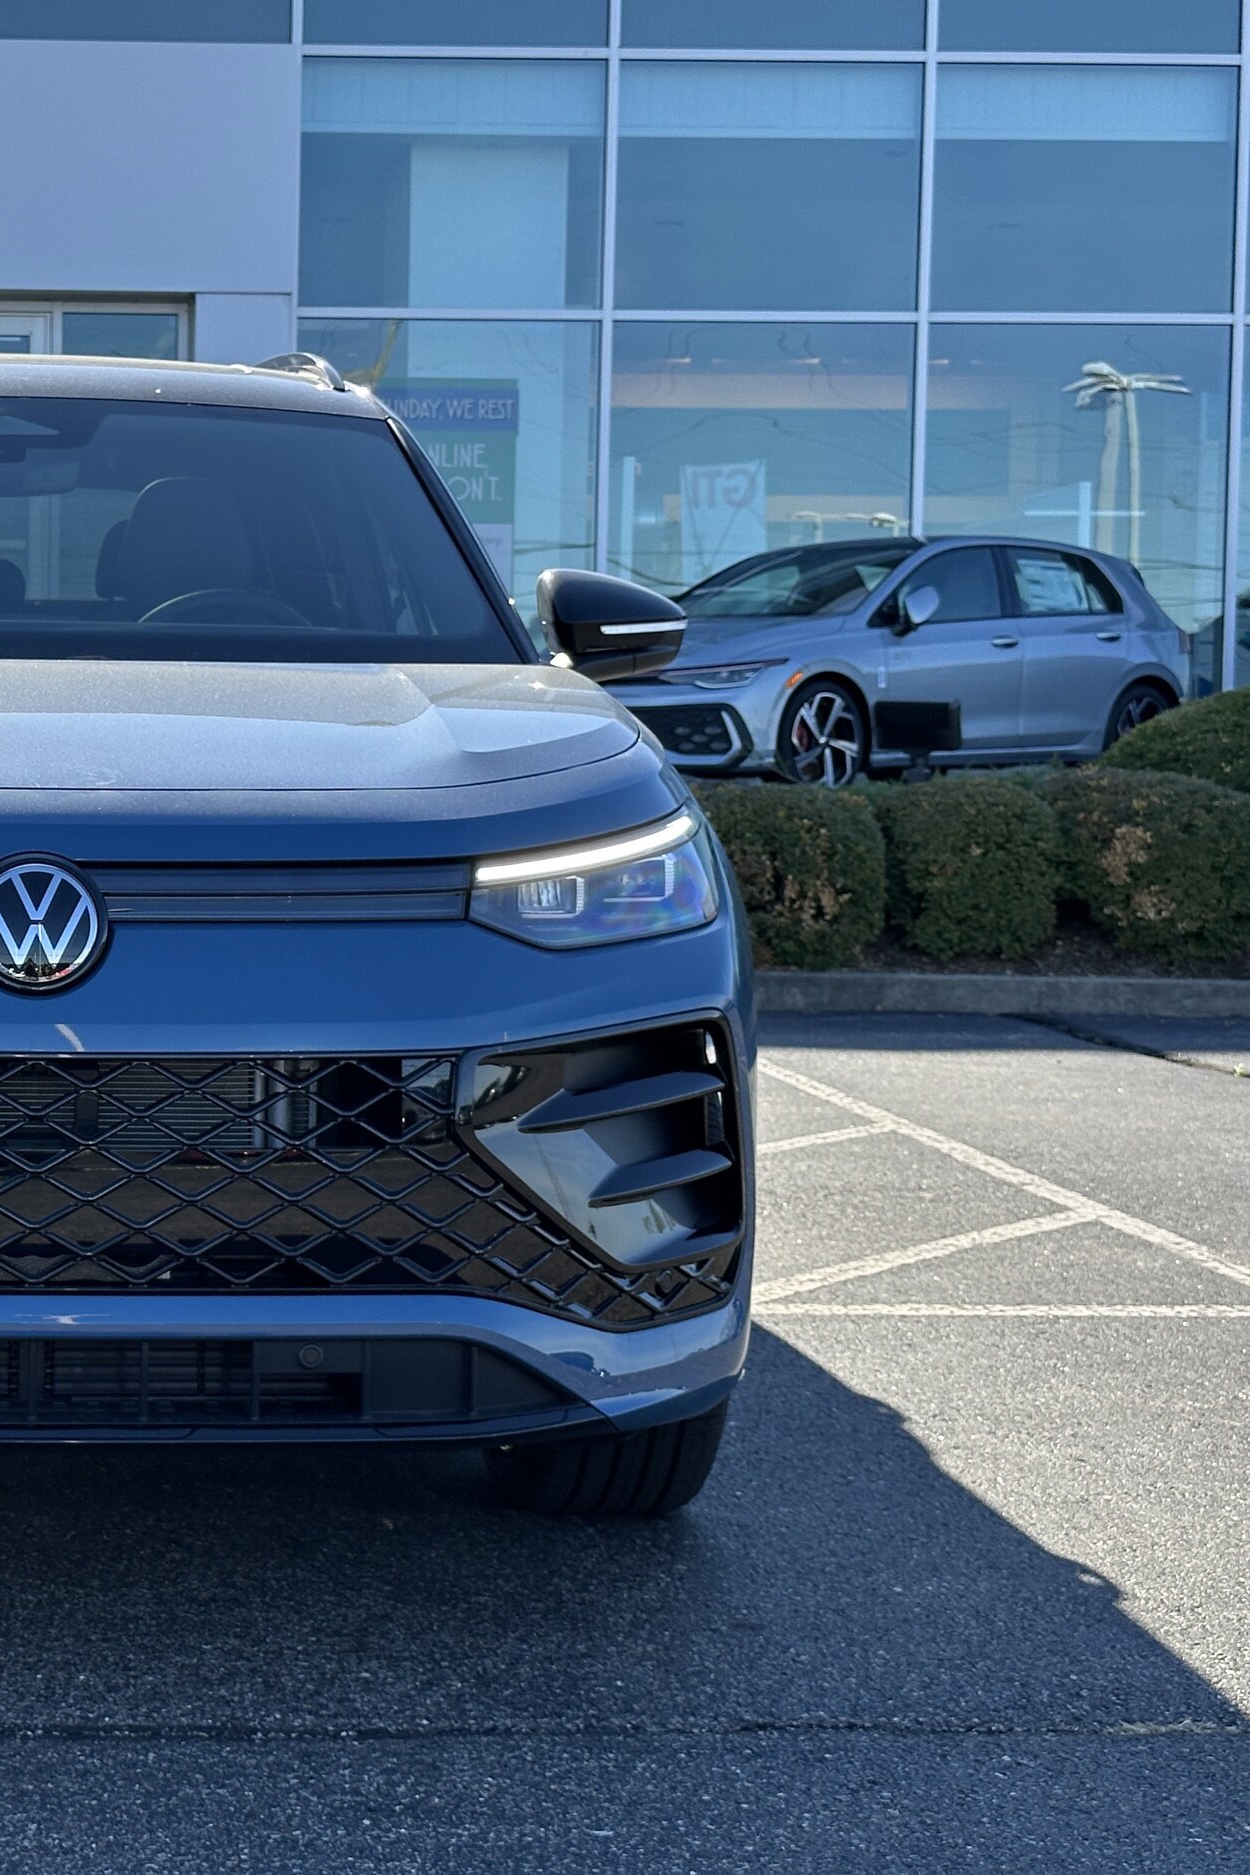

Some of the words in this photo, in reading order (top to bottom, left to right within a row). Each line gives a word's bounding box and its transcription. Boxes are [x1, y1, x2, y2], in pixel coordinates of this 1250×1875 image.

[446, 399, 475, 420] WE
[478, 399, 515, 420] REST
[427, 442, 489, 470] NLINE,
[447, 471, 503, 501] ON'T.
